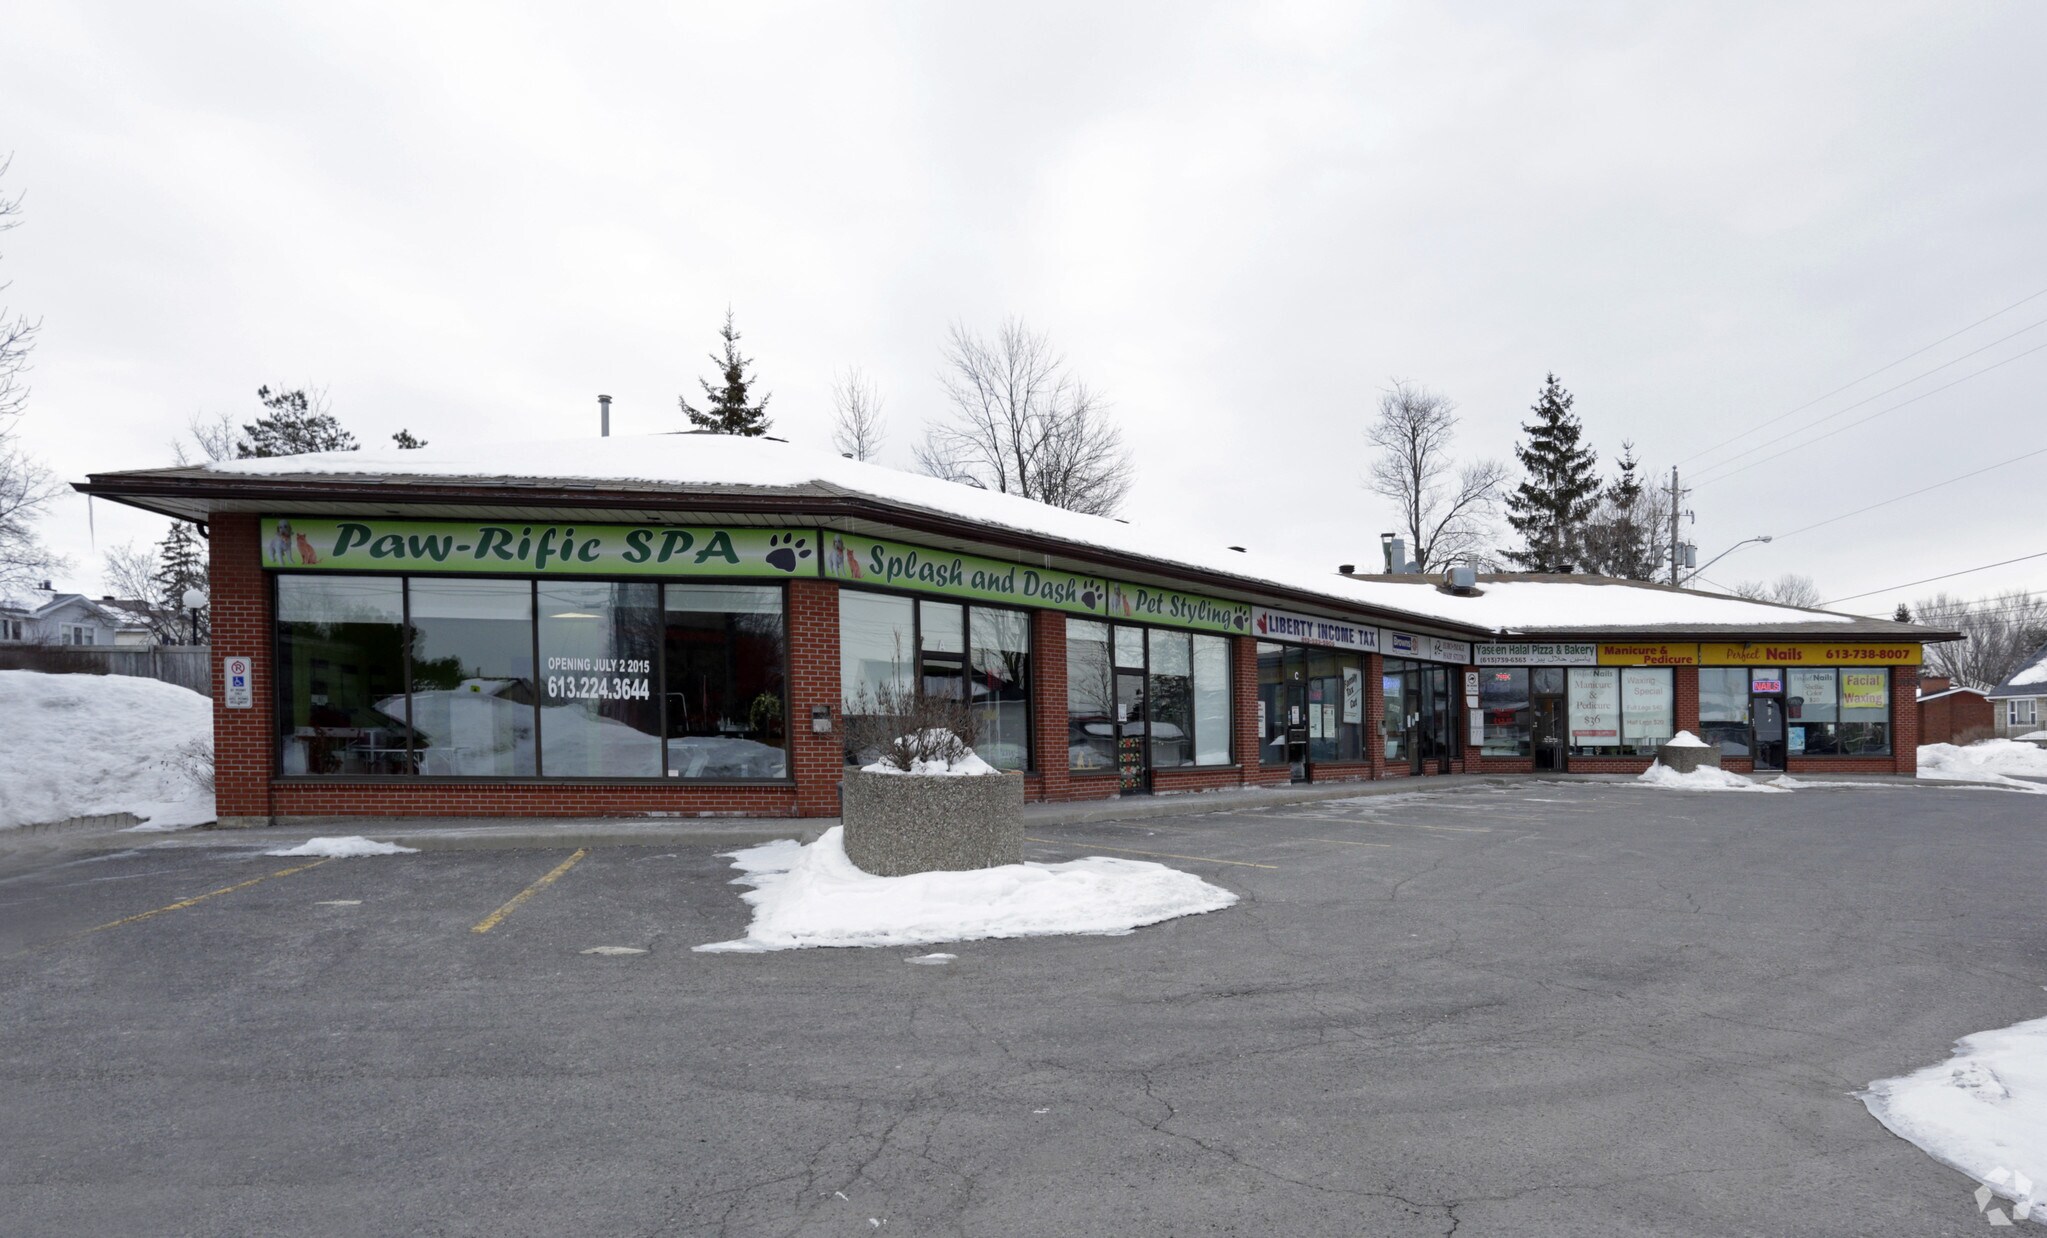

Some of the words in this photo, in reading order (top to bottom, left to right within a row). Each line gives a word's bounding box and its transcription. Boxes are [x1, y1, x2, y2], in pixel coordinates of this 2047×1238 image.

[332, 523, 600, 570] Paw-Rific
[622, 529, 740, 565] SPA
[869, 544, 963, 587] Splash
[970, 566, 1016, 594] and
[1023, 570, 1077, 604] Dash
[1135, 589, 1163, 615] Pet
[1169, 594, 1231, 630] Styling
[1268, 615, 1313, 638] LIBERTY
[1317, 622, 1355, 644] INCOME
[1358, 629, 1376, 648] TAX
[1476, 645, 1506, 655] Yaseen
[1509, 645, 1530, 655] Halal
[1532, 645, 1554, 655] Pizza
[1556, 645, 1563, 655] &
[1564, 645, 1595, 656] Bakery
[1604, 646, 1657, 655] Manicure
[1660, 646, 1668, 655] &
[1726, 648, 1761, 660] Perfect
[1766, 648, 1803, 660] Nails
[1826, 649, 1910, 660] 613-738-8007
[1644, 655, 1693, 664] Pedicure
[548, 657, 591, 671] OPENING
[593, 659, 617, 672] JULY
[619, 660, 626, 673] 2
[627, 660, 650, 674] 2015
[1294, 671, 1299, 680] C
[1593, 670, 1613, 678] Nails
[1575, 681, 1612, 689] Manicure
[1847, 675, 1880, 686] Facial
[547, 676, 650, 700] 613.224.3644
[1634, 687, 1663, 697] Special
[1755, 682, 1780, 691] NAILS
[1589, 691, 1598, 699] &
[1844, 692, 1882, 706] Waxing
[1576, 701, 1611, 709] Pedicure
[1584, 714, 1601, 727] $36
